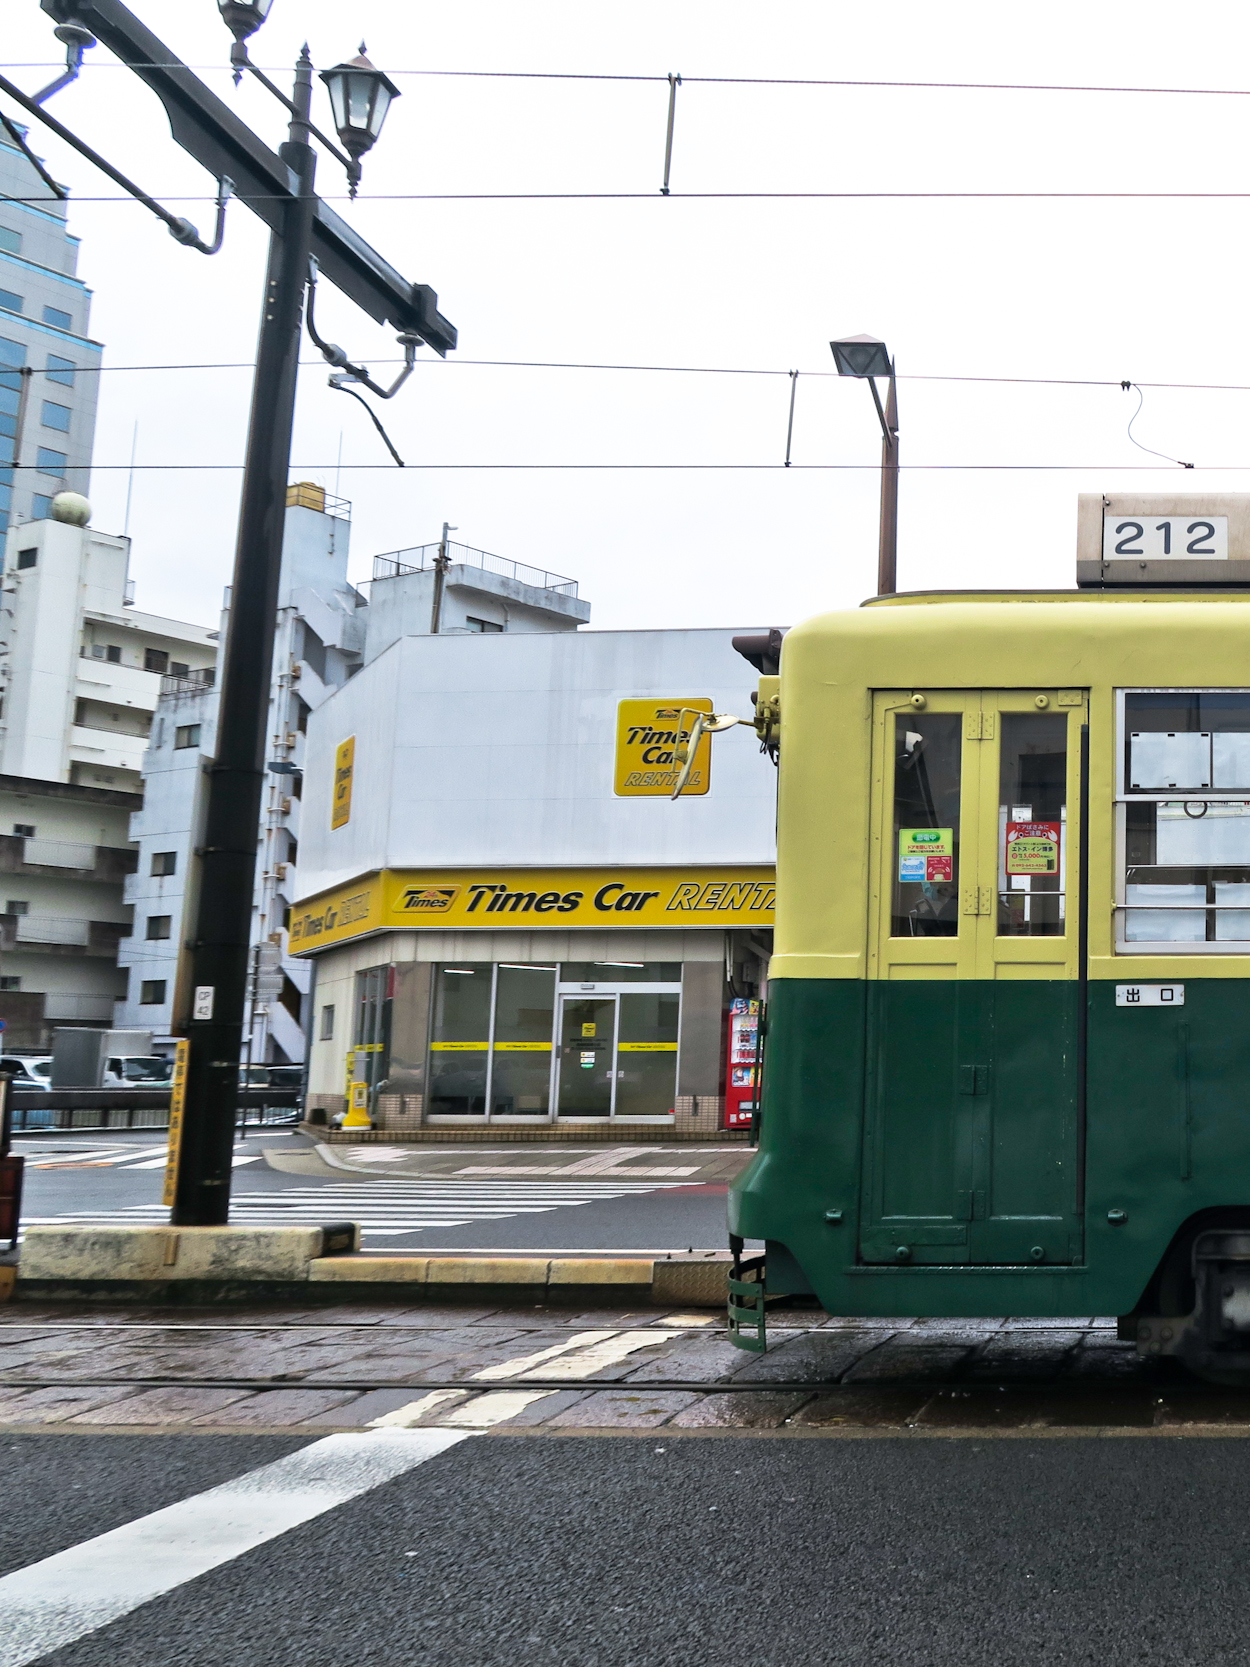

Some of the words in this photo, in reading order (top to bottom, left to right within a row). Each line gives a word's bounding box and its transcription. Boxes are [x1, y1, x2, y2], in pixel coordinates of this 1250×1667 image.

[1115, 521, 1216, 555] 212
[642, 746, 684, 765] Ca
[403, 890, 455, 908] Times
[466, 884, 584, 913] Times
[594, 882, 660, 912] Car
[665, 882, 776, 911] RENT
[1126, 987, 1174, 1003] 出口
[196, 1005, 210, 1016] 42
